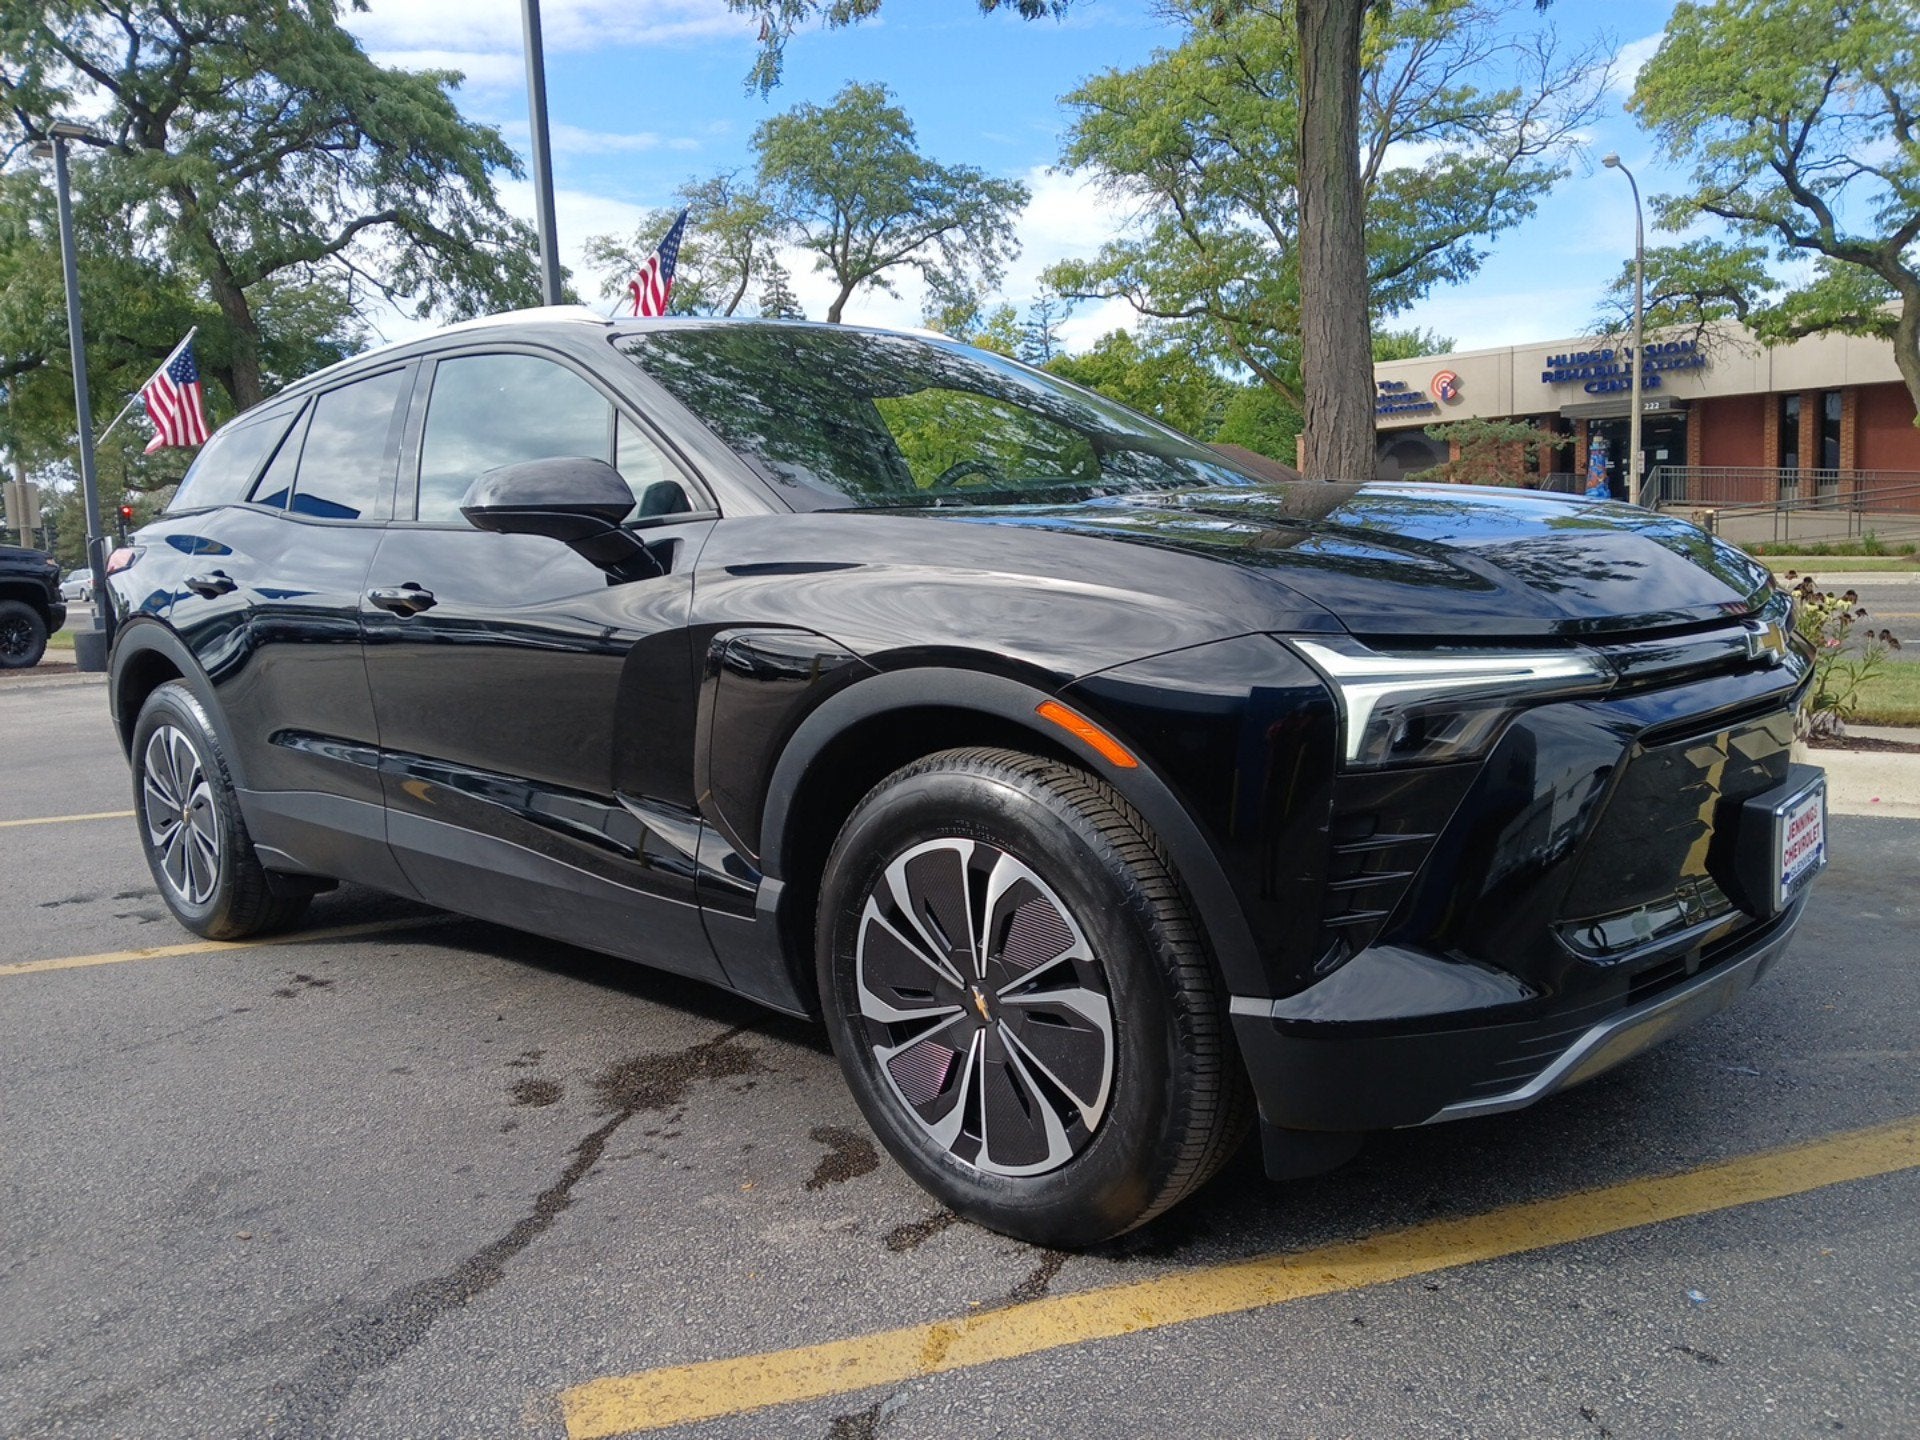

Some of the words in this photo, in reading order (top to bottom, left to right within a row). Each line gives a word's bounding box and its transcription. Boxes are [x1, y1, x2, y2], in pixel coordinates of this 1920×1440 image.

[1541, 353, 1706, 383] REHABILIATION
[1644, 402, 1660, 410] 222
[1786, 803, 1818, 842] JENNINGS
[1783, 822, 1820, 867] CHEVROLET
